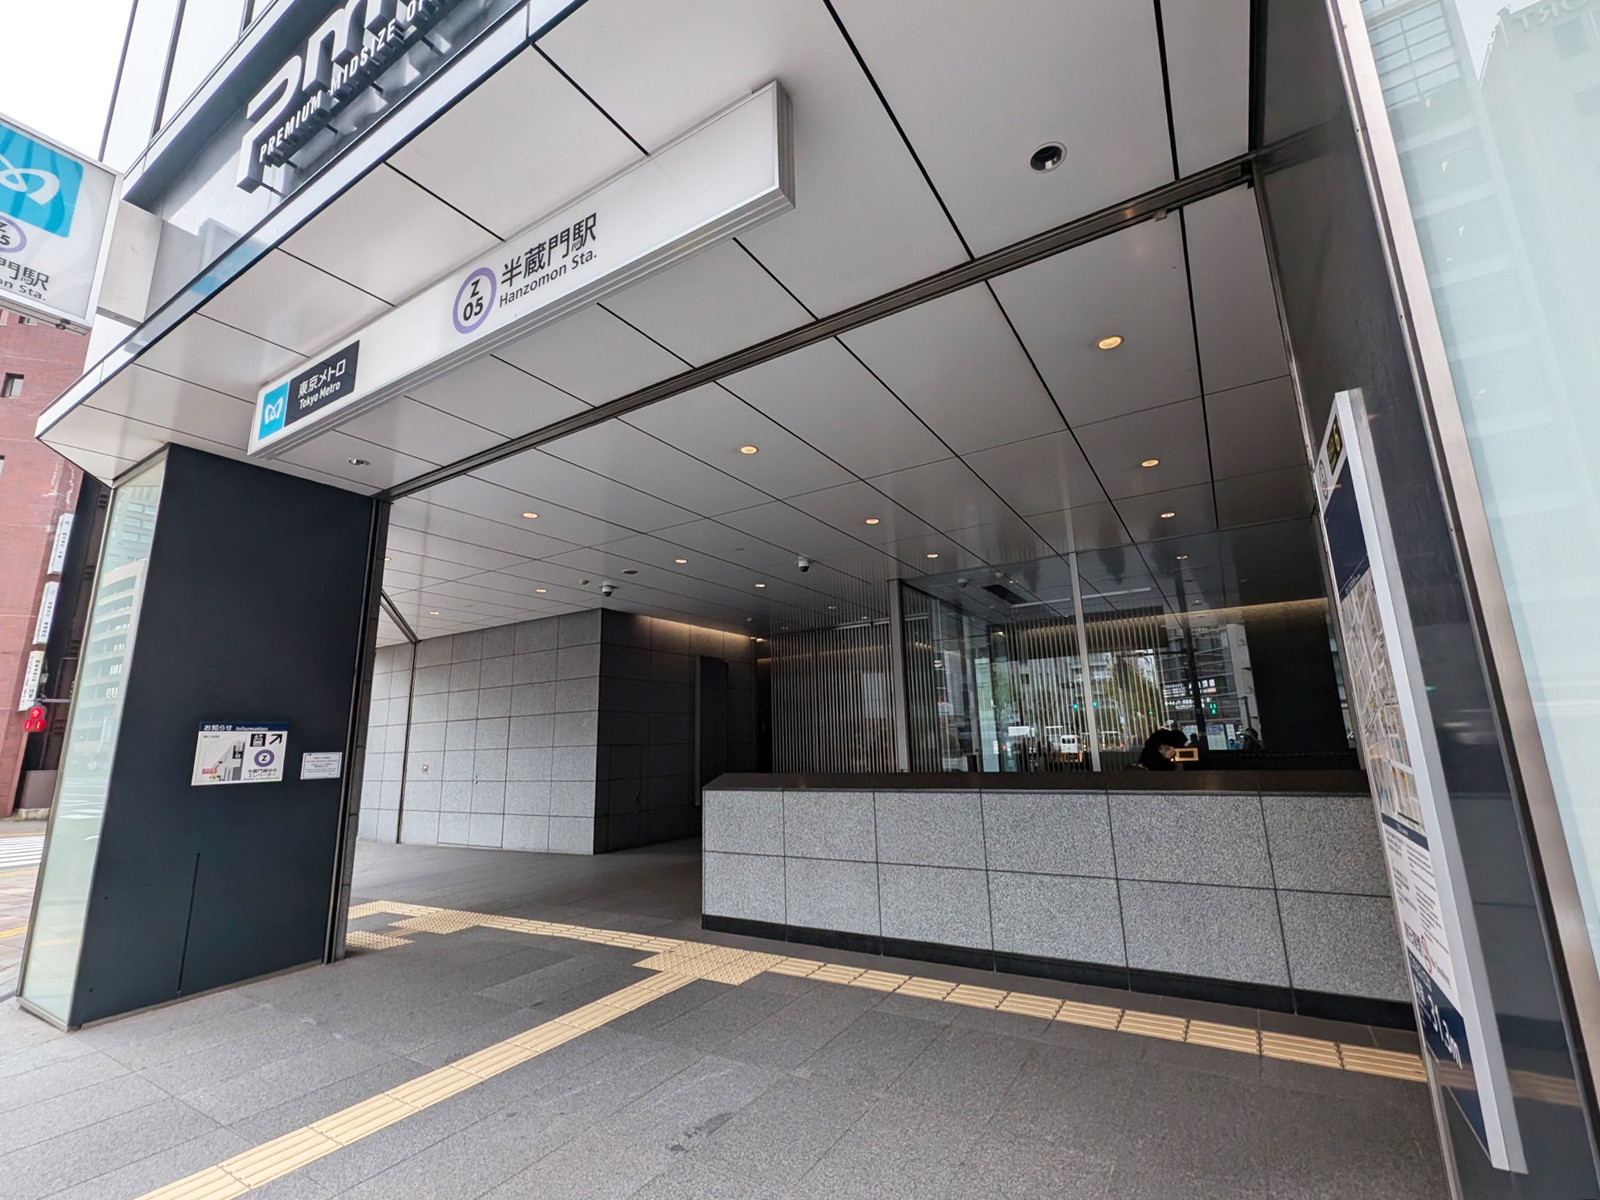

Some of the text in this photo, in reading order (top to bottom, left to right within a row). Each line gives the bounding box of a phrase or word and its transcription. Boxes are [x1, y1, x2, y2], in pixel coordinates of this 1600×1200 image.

[259, 90, 322, 164] PREMIUM
[330, 18, 396, 96] MIDSIZE
[500, 212, 597, 288] 半蔵門駅
[18, 284, 46, 301] Sta.
[470, 278, 481, 299] Z
[499, 250, 597, 308] Hanzomon Sta.
[463, 296, 484, 322] 05
[298, 358, 346, 398] 東京メトロ
[299, 381, 341, 410] Tokyo Metro
[203, 724, 233, 732] お知らせ
[261, 754, 267, 762] Z
